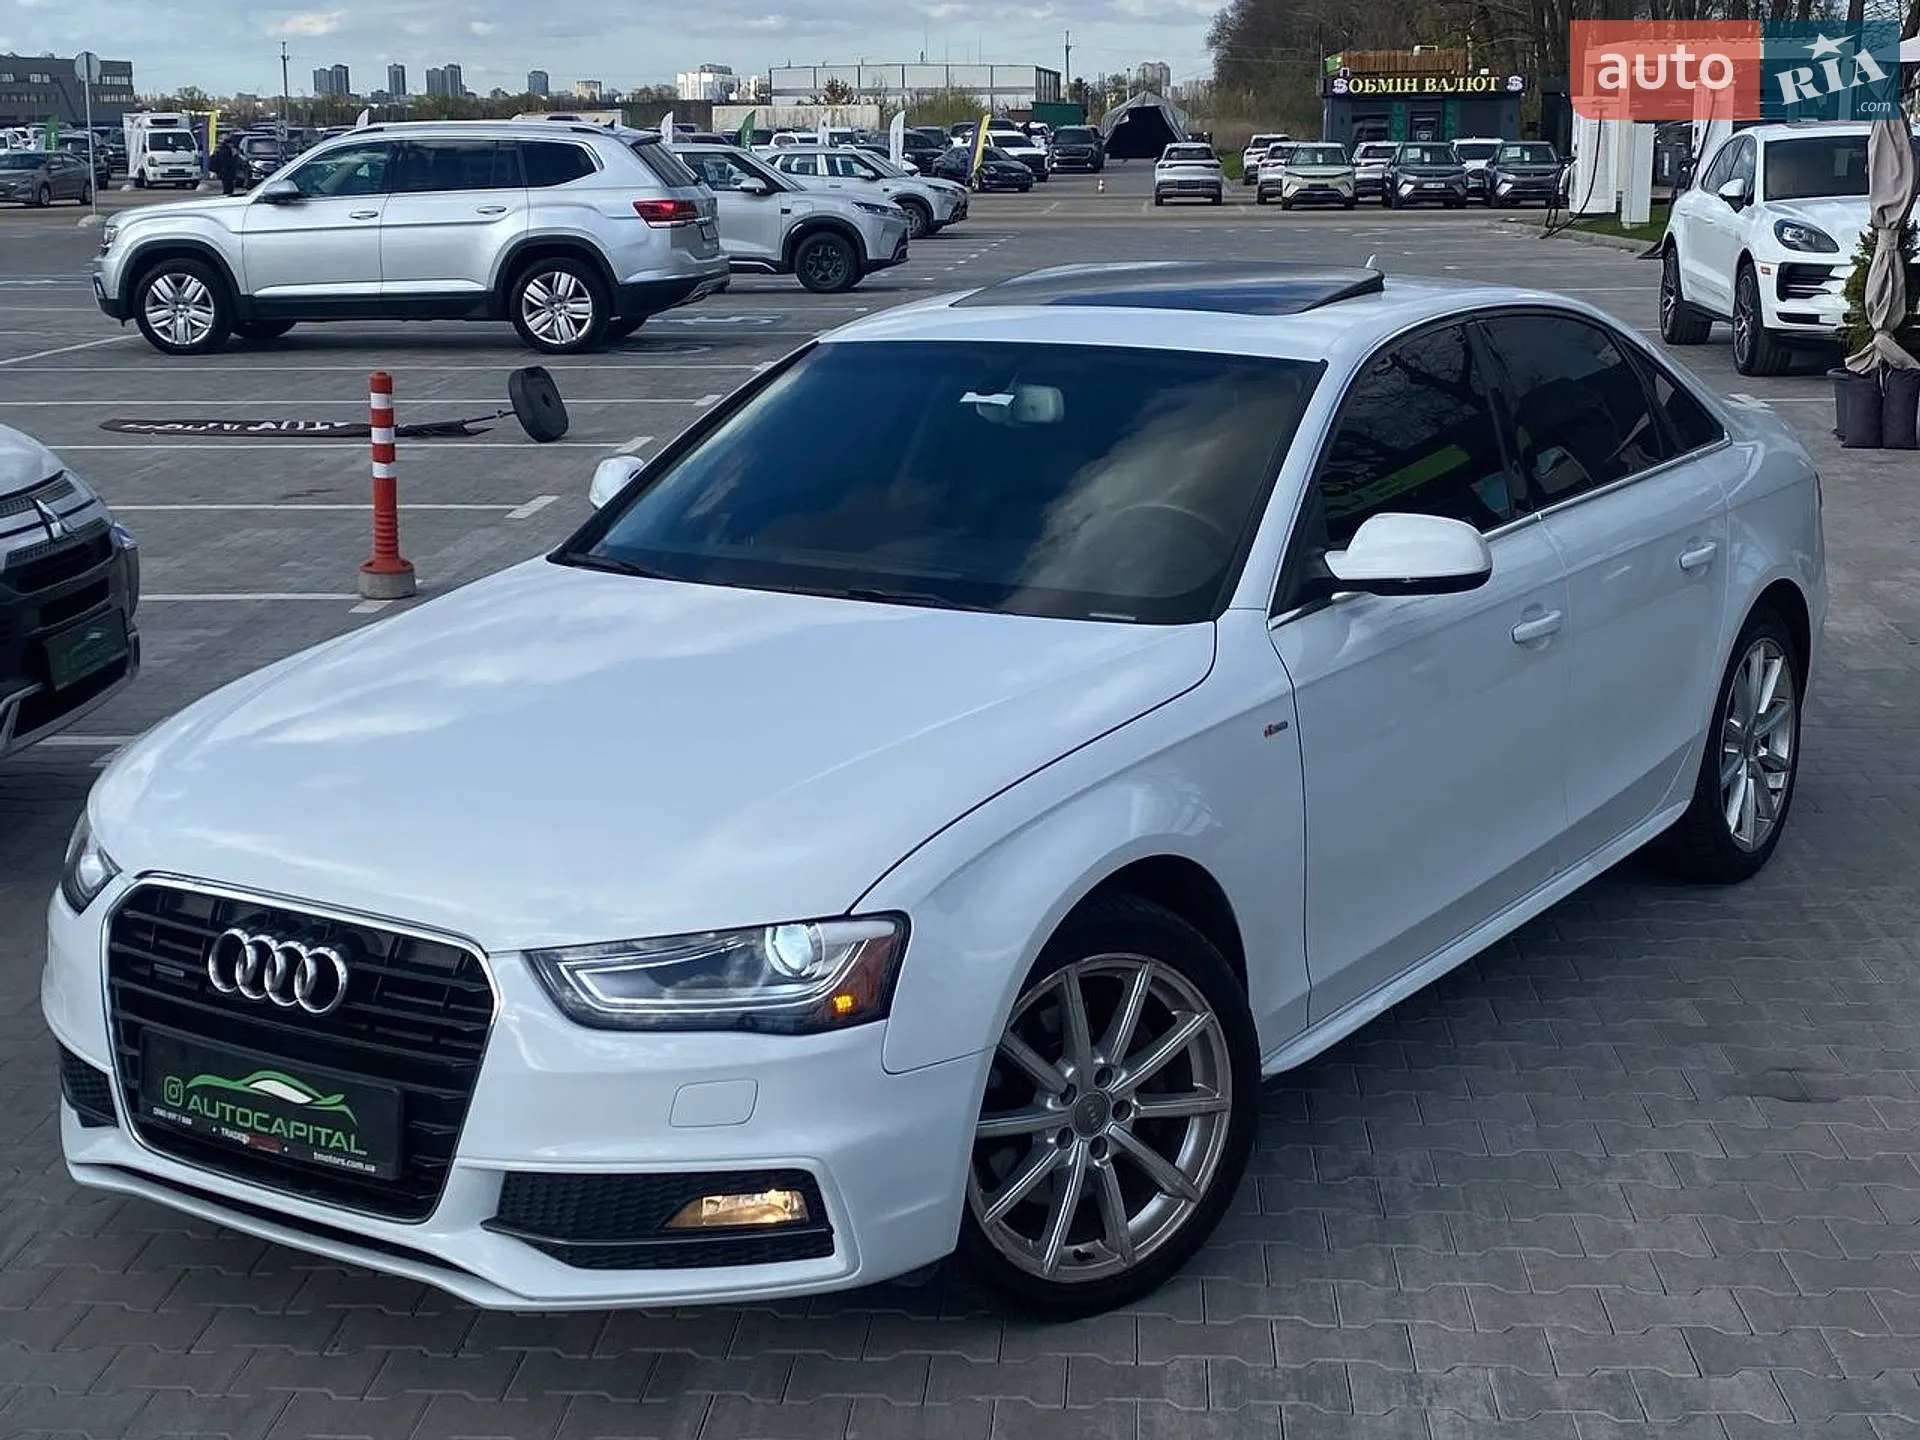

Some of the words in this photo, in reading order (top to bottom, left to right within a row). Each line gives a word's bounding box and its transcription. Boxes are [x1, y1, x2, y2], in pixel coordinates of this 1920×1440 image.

[1349, 76, 1418, 94] ОБМІН
[1424, 75, 1500, 92] ВАЛЮТ
[187, 1095, 368, 1156] AUTOCAPITAL
